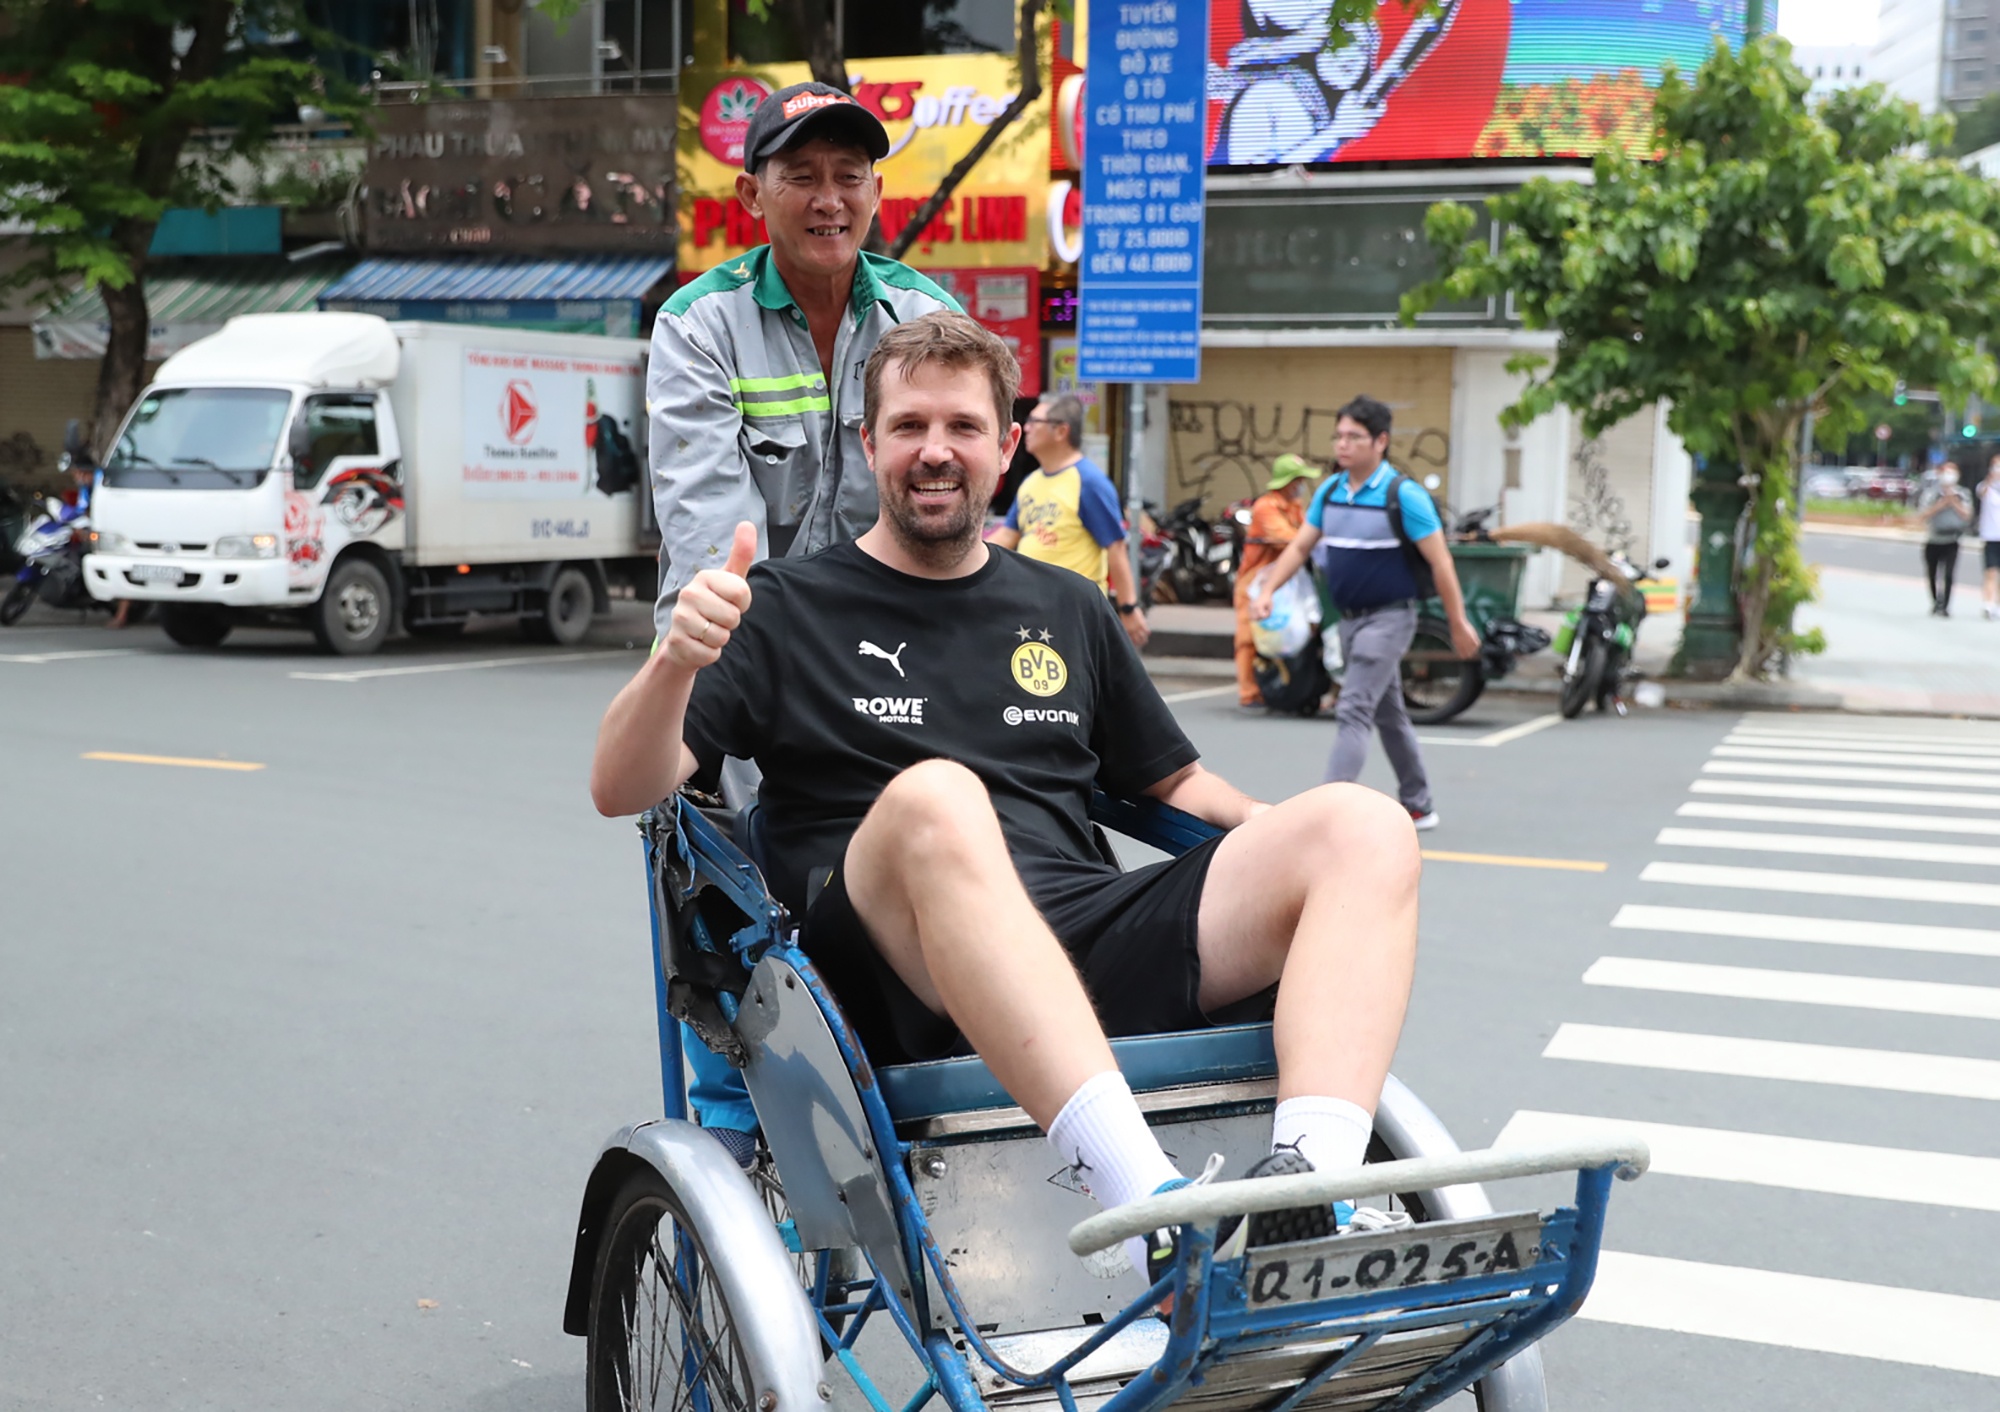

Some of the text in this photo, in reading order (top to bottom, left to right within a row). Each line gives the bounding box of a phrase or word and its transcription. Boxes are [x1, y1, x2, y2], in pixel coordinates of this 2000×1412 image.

[1149, 53, 1173, 74] XE
[785, 93, 851, 113] Supre
[1096, 98, 1197, 126] CÓ THU PHÍ
[1122, 128, 1168, 149] THEO
[1106, 174, 1181, 199] MỨC PHÍ
[1084, 198, 1201, 224] TRONG 01 GIỜ
[1019, 649, 1060, 680] BVB
[1033, 680, 1049, 690] 09
[852, 697, 924, 716] ROWE
[879, 715, 924, 725] MOTOR OIL
